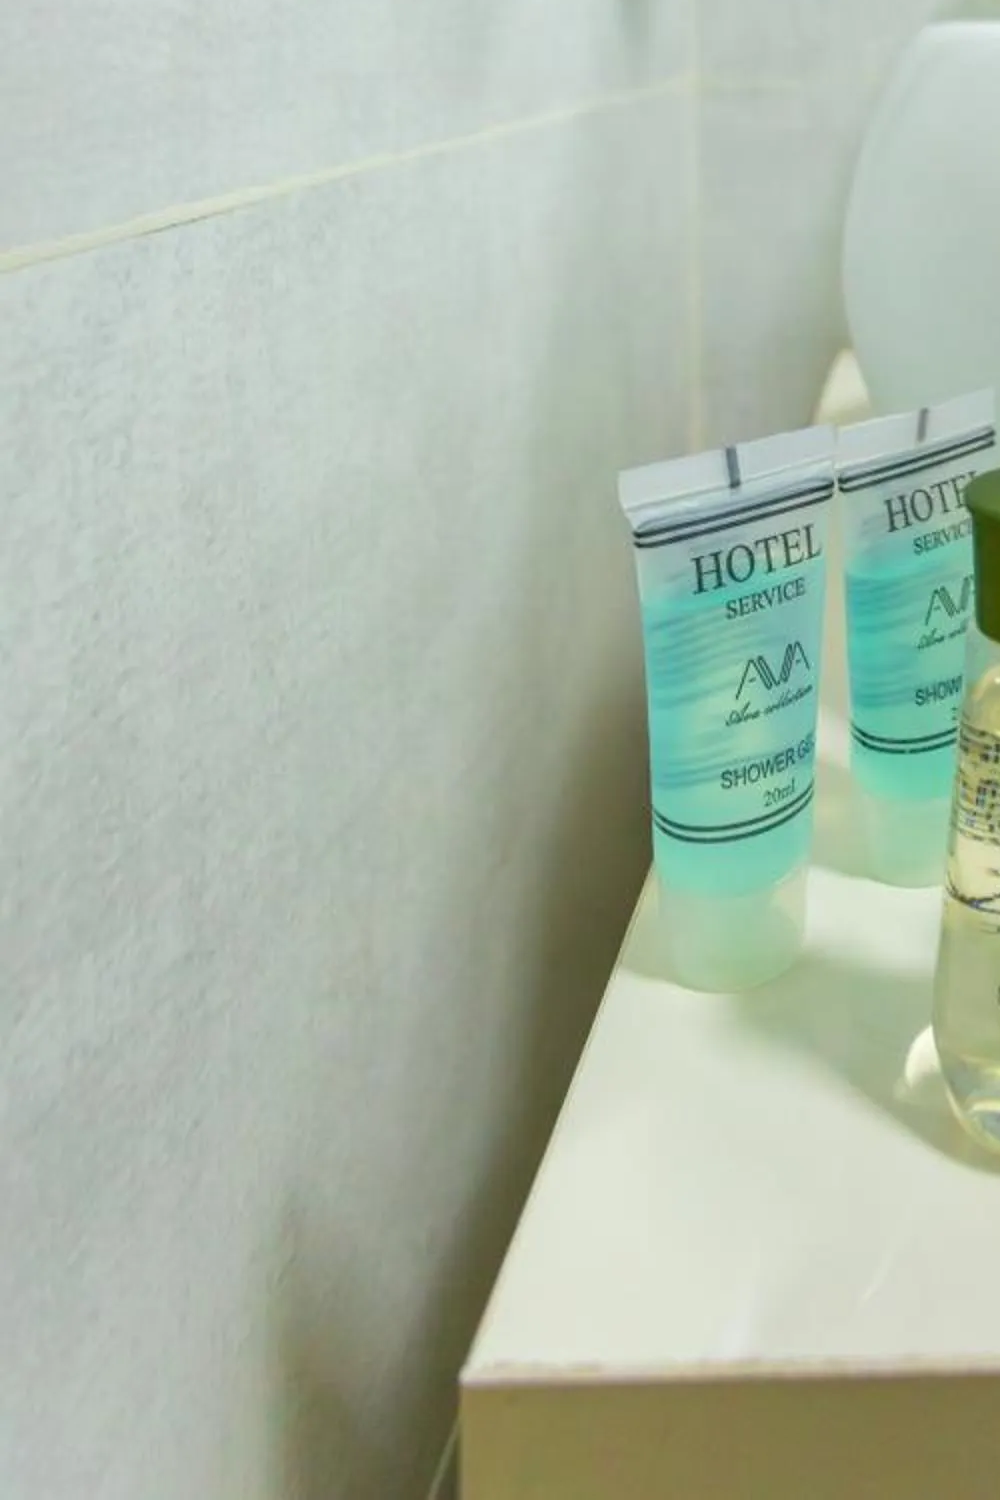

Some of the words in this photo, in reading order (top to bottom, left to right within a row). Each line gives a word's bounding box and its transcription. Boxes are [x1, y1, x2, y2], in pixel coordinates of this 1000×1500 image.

[884, 470, 977, 533] HOTE
[691, 524, 822, 596] HOTEL
[725, 576, 806, 621] SERVICE
[735, 640, 811, 700] AVA
[720, 747, 795, 791] SHOWER
